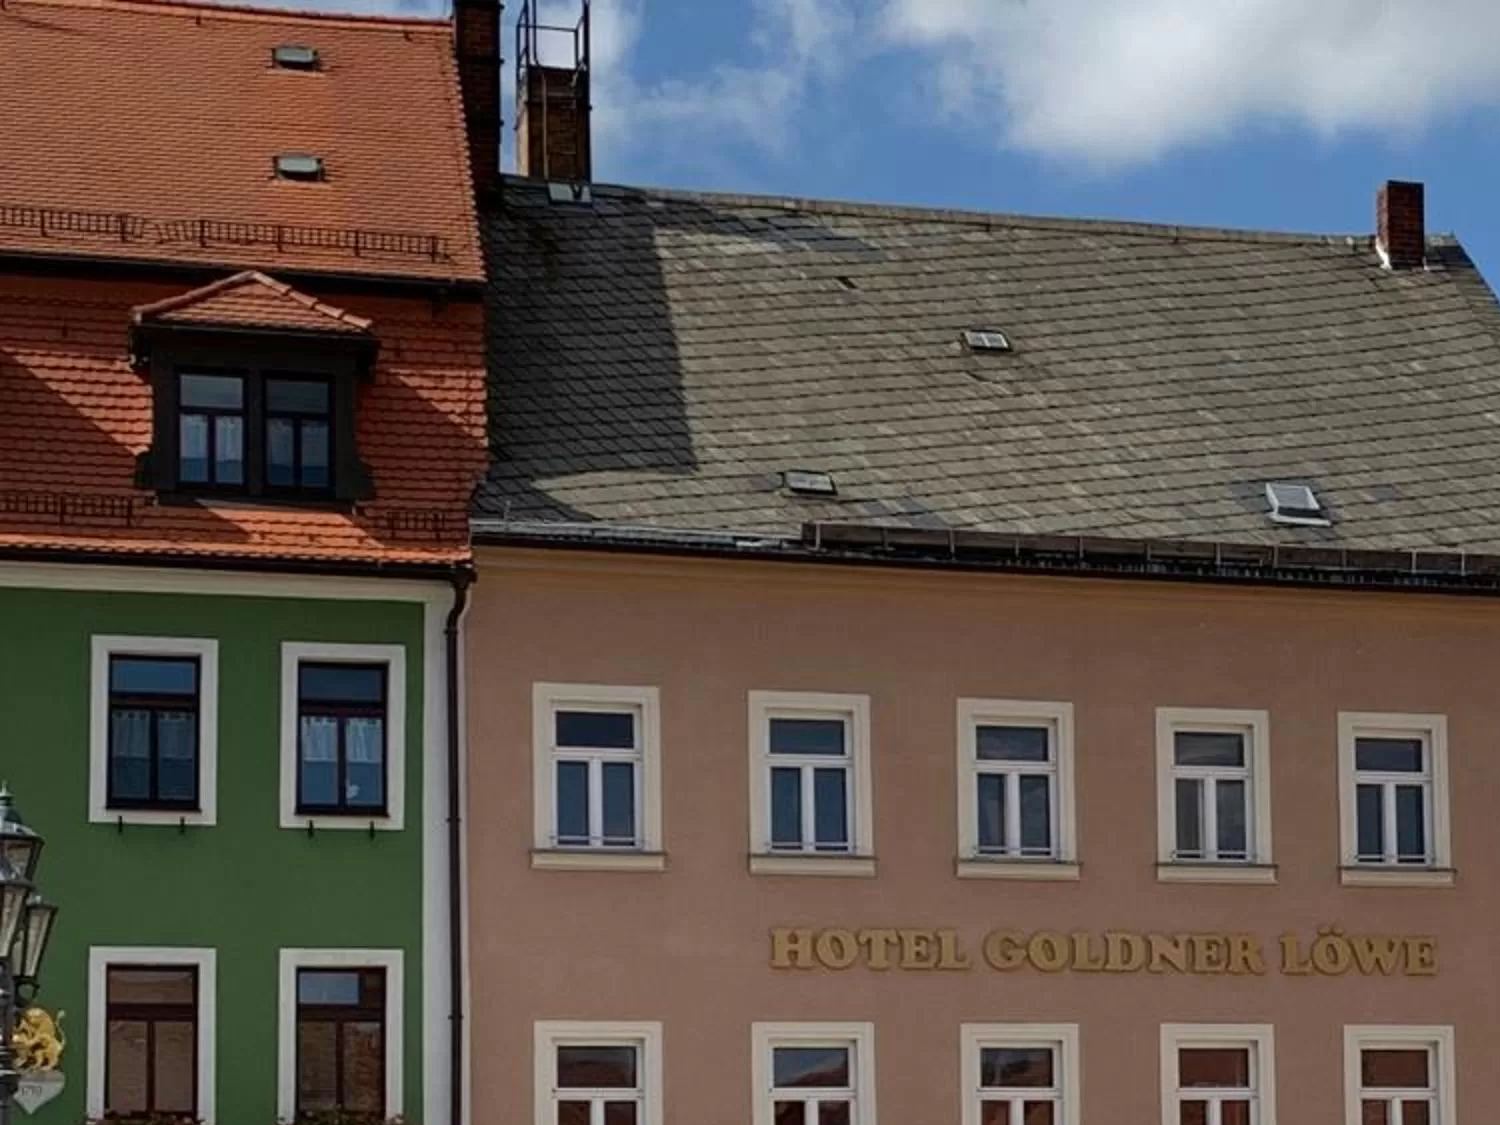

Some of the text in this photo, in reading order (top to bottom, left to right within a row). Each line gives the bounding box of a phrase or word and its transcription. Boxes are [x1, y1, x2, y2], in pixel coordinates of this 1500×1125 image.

[769, 925, 1440, 977] HOTEL GOLDNER LÖWE
